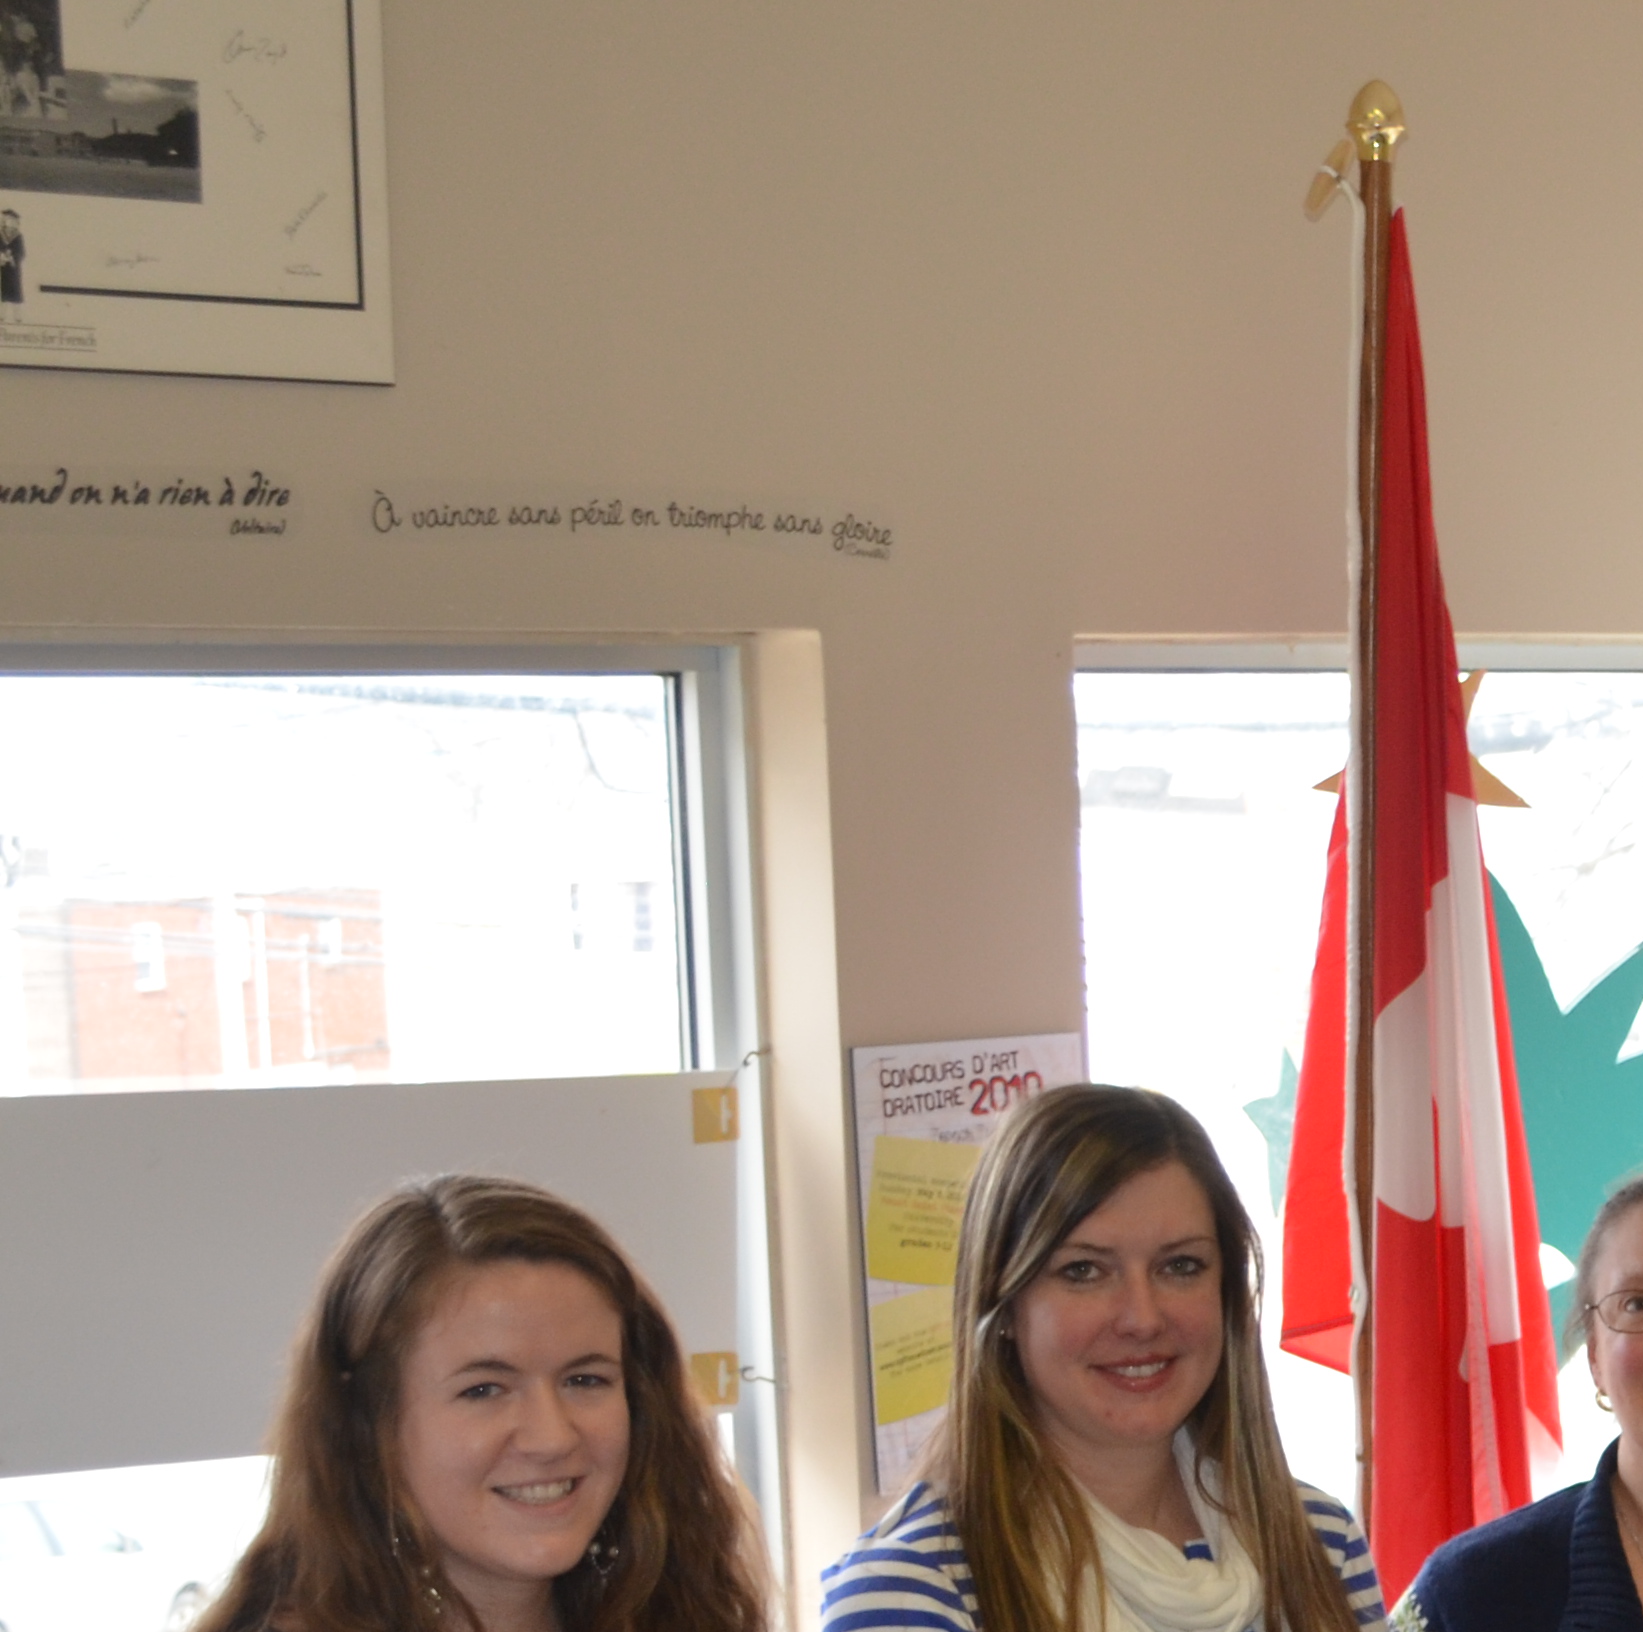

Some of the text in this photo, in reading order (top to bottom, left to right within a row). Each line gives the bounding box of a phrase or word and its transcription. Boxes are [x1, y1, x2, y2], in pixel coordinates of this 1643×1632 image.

[68, 484, 103, 506] on
[158, 478, 211, 507] rien
[218, 476, 236, 506] à
[243, 470, 291, 507] dire
[373, 489, 894, 551] À vaincre sans péril on triomphe sans gloire
[878, 1050, 1020, 1092] CONCOURS D'ART
[883, 1086, 966, 1119] ORATOIRE
